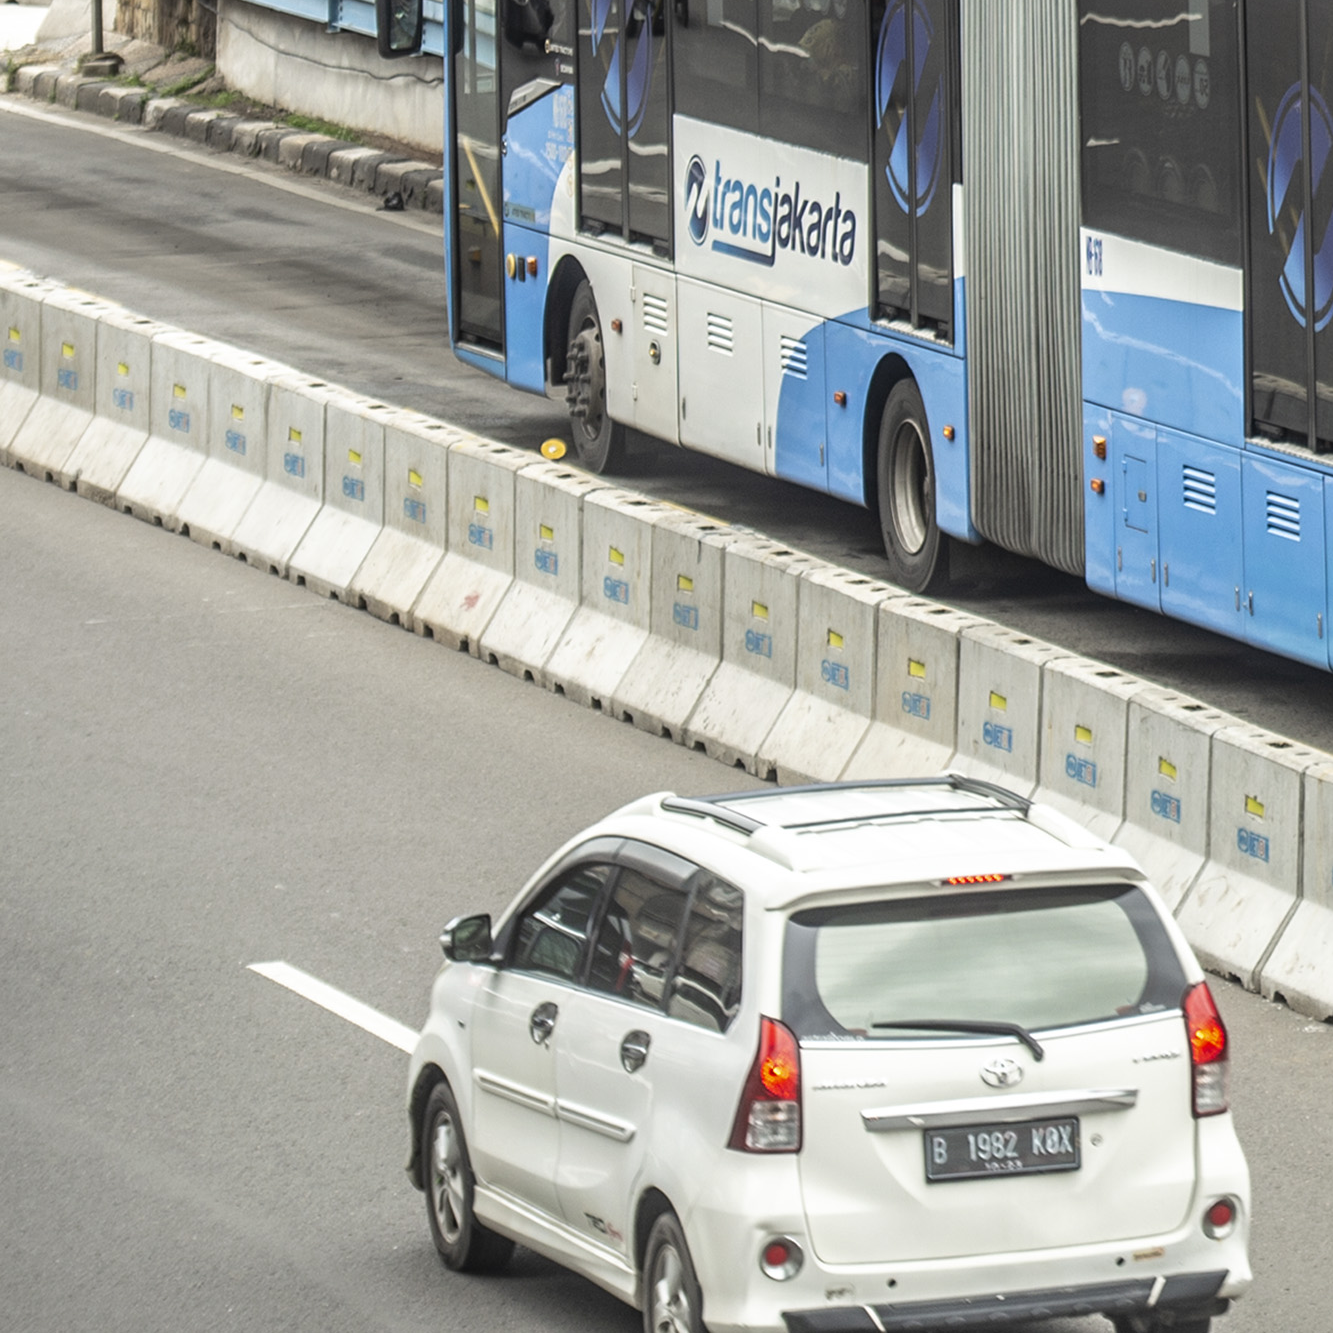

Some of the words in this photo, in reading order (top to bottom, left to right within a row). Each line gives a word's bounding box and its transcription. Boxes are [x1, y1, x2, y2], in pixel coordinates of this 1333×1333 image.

[712, 160, 857, 267] transjakarta
[933, 1137, 947, 1164] B
[967, 1131, 1019, 1161] 1982
